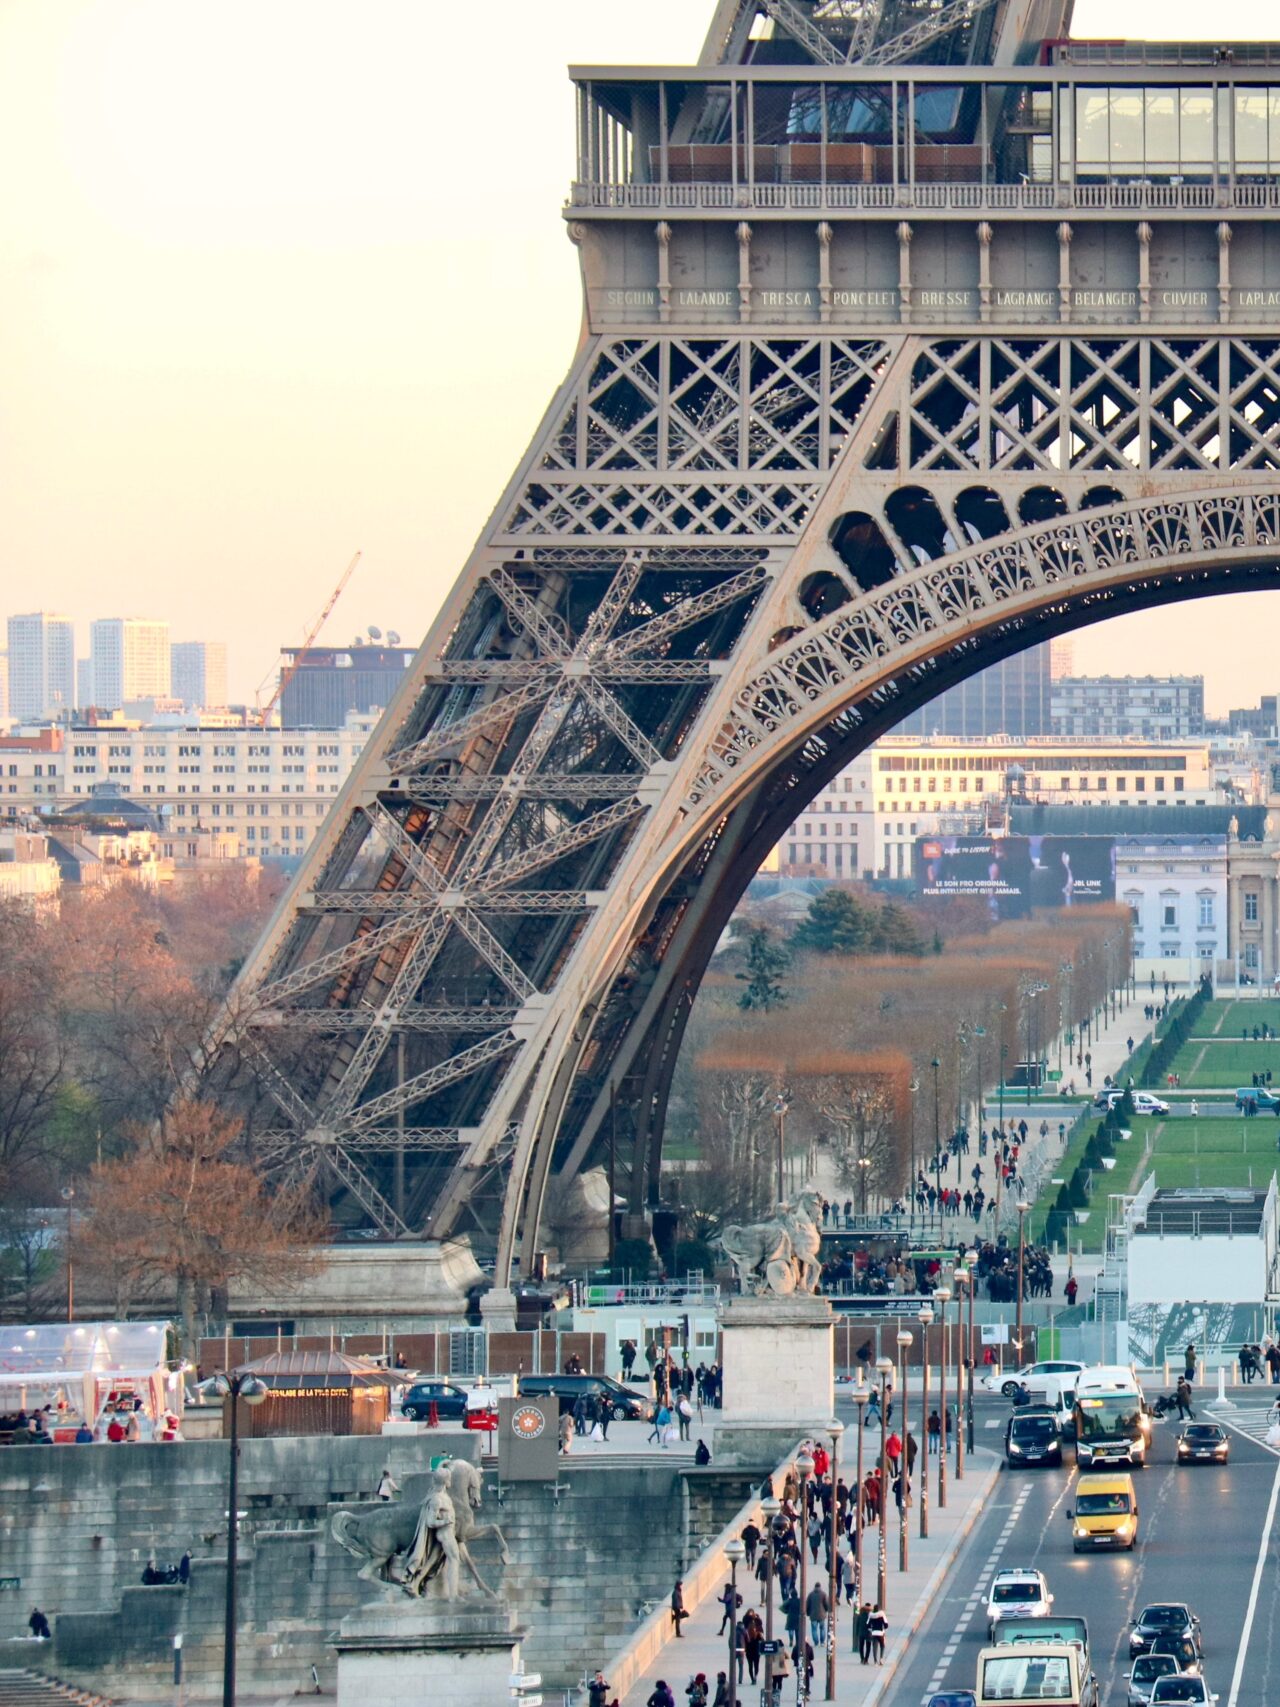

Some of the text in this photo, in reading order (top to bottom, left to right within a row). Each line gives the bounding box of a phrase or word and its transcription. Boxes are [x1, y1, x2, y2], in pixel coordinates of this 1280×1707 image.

[607, 292, 654, 305] SEGUIN
[679, 292, 732, 305] LALANDE
[761, 292, 812, 305] TRESCA
[833, 292, 897, 305] PONCELET
[921, 292, 970, 305] BRESSE
[997, 292, 1055, 306] LAGRANGE
[1074, 292, 1136, 305] BELANGER
[1163, 292, 1208, 305] CUVIER
